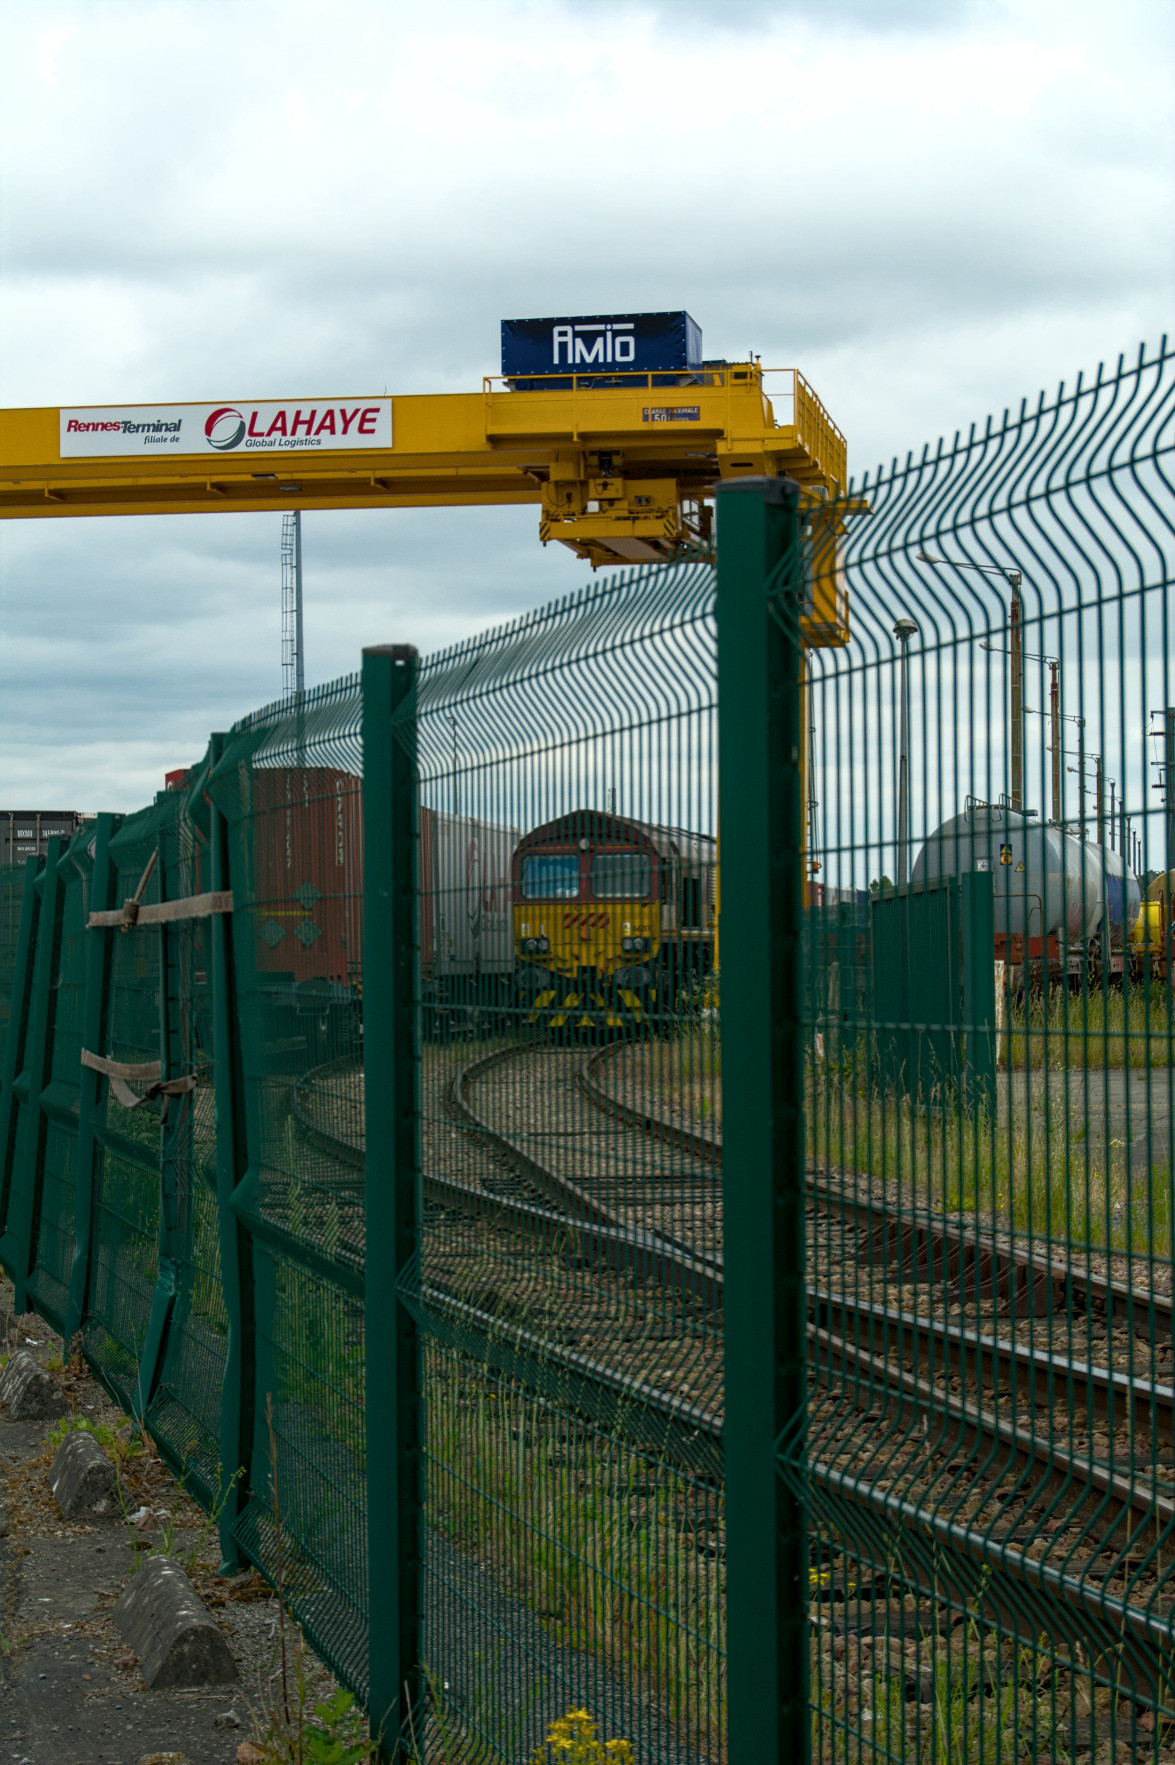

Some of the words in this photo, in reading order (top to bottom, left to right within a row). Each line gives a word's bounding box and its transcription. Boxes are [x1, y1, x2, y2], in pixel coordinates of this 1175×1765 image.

[247, 407, 381, 438] LAHAYE
[144, 435, 169, 445] filiale
[169, 434, 180, 443] de
[245, 438, 276, 448] Global
[278, 437, 322, 449] Logistics
